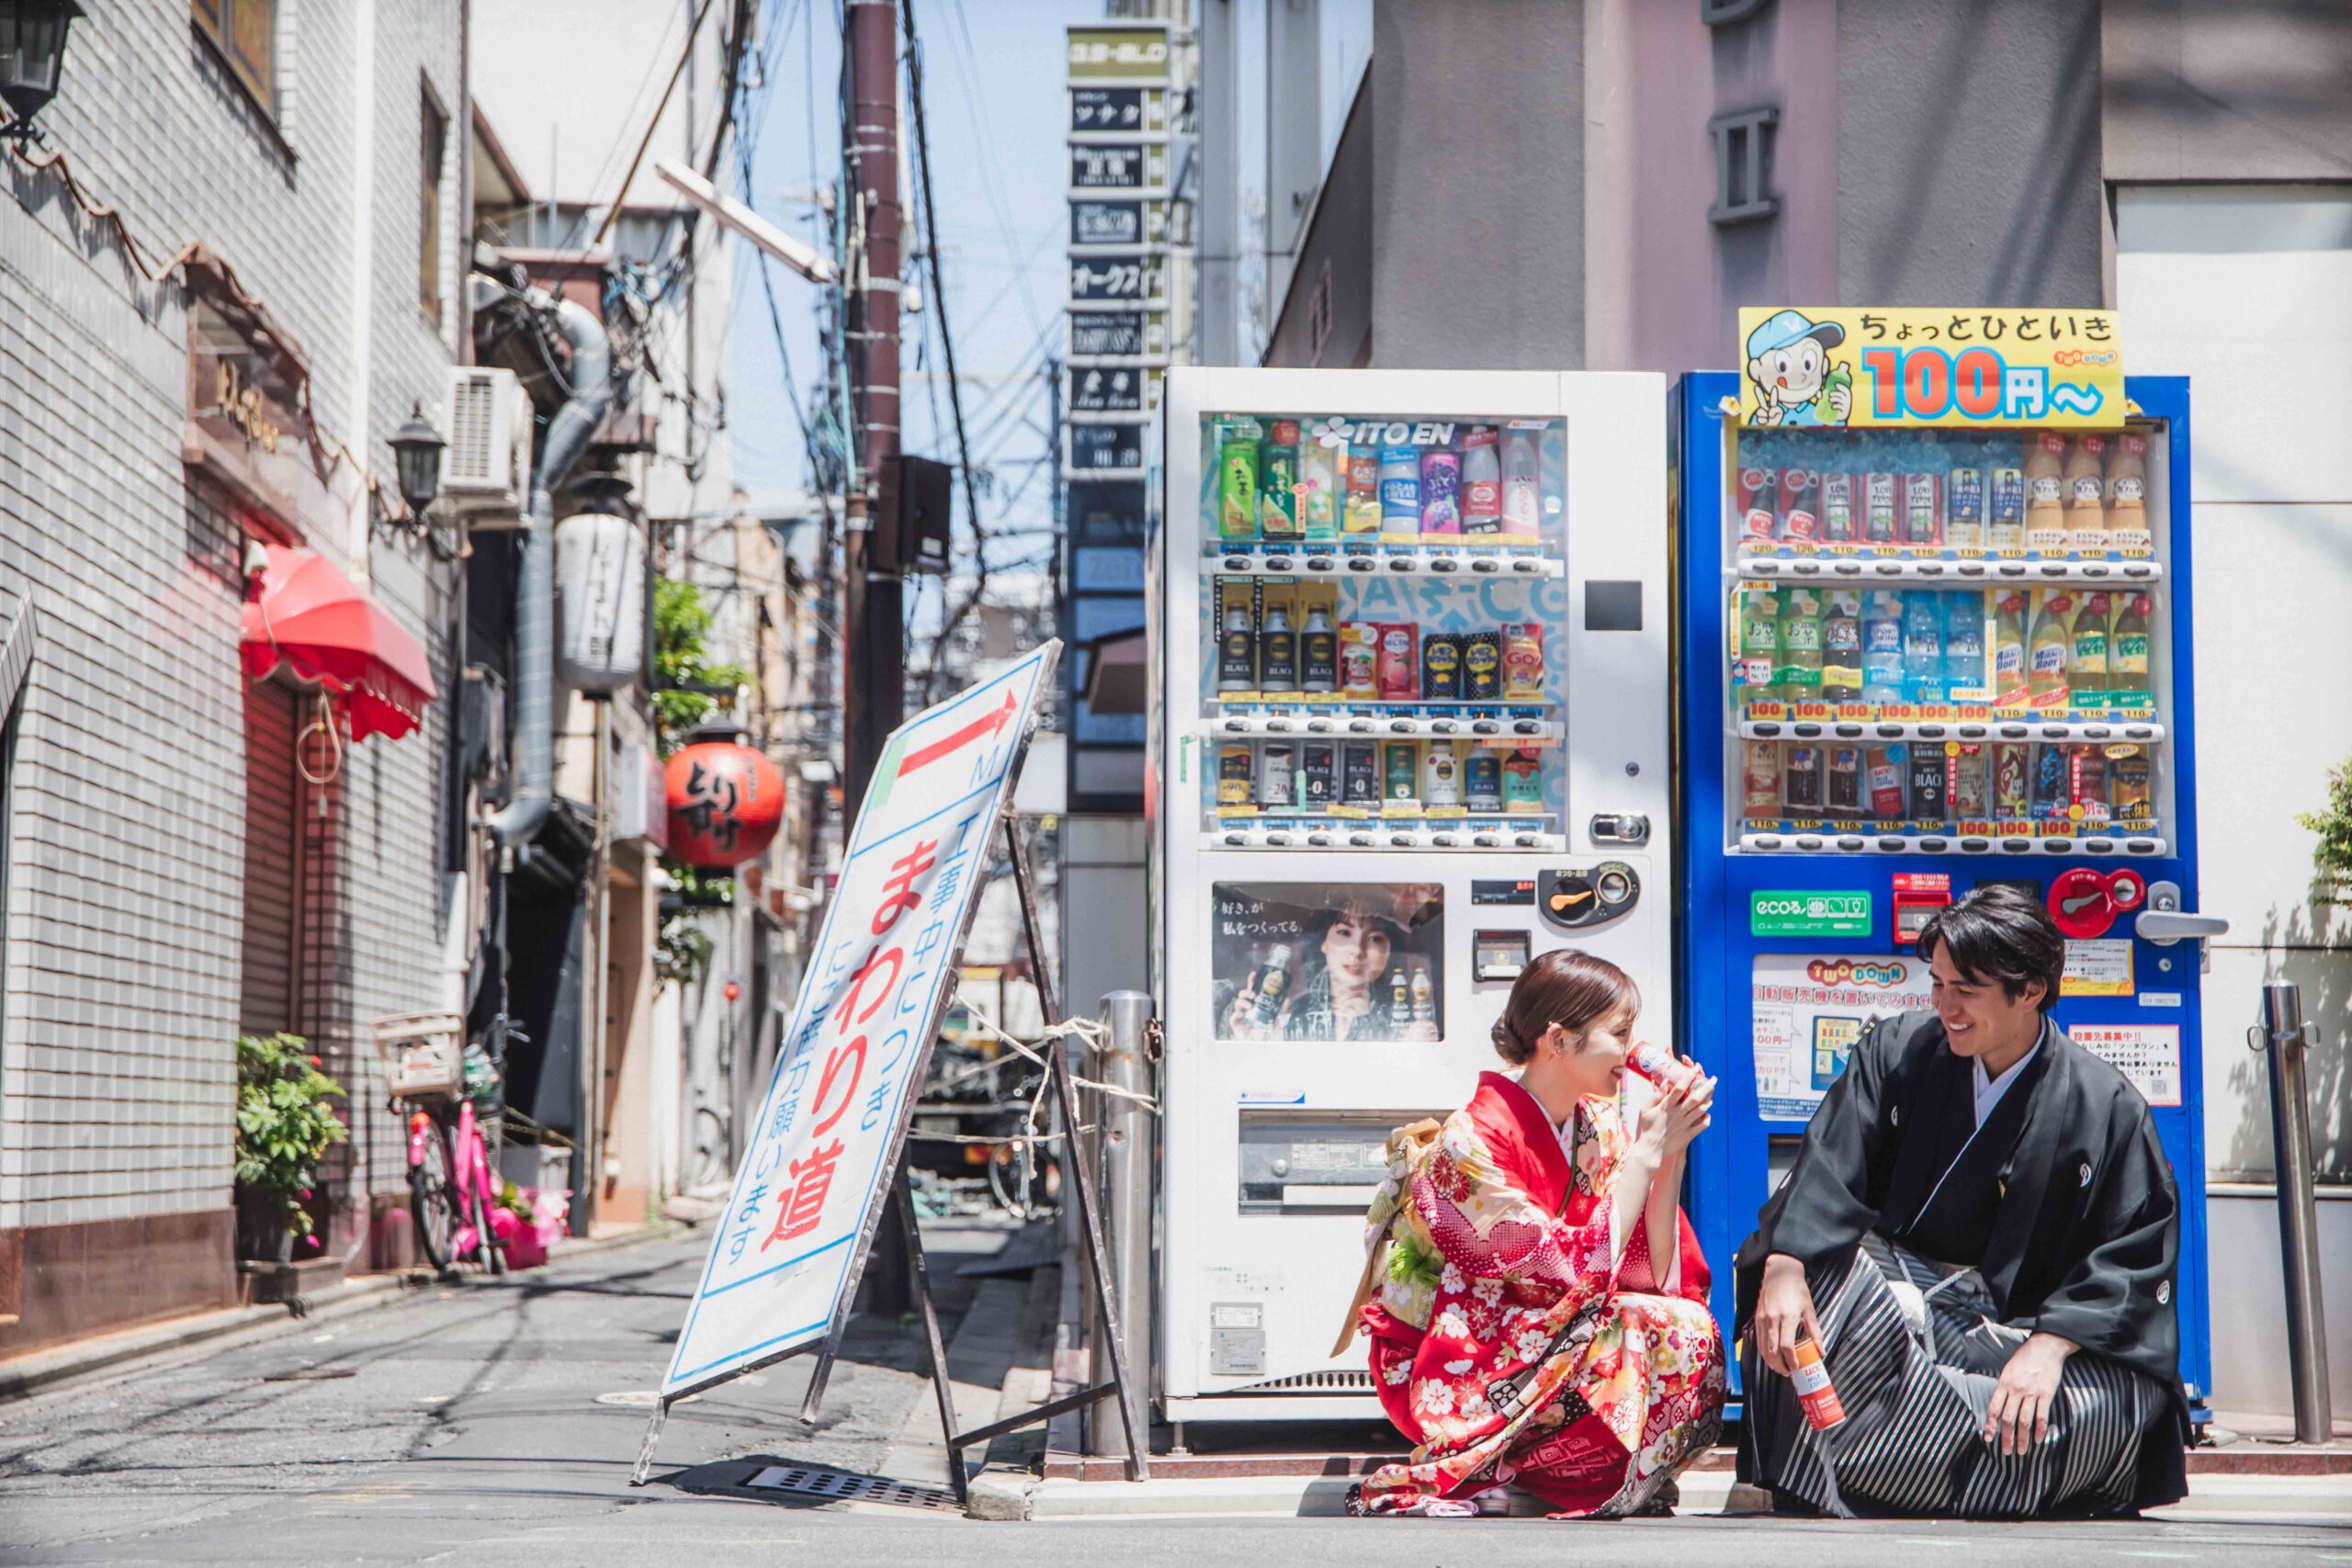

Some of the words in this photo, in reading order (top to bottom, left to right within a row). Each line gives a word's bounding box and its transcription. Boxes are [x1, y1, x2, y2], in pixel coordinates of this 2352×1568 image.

[1860, 314, 2111, 341] ちょっとひといき
[1353, 423, 1408, 445] ITO
[1412, 423, 1454, 445] EN
[1221, 902, 1264, 915] 好き、が
[861, 812, 980, 1132] 工事中につき
[1813, 963, 1850, 982] TWO
[1855, 964, 1901, 983] DOWN
[761, 838, 939, 1254] まわり道
[729, 941, 853, 1266] にご協力願います
